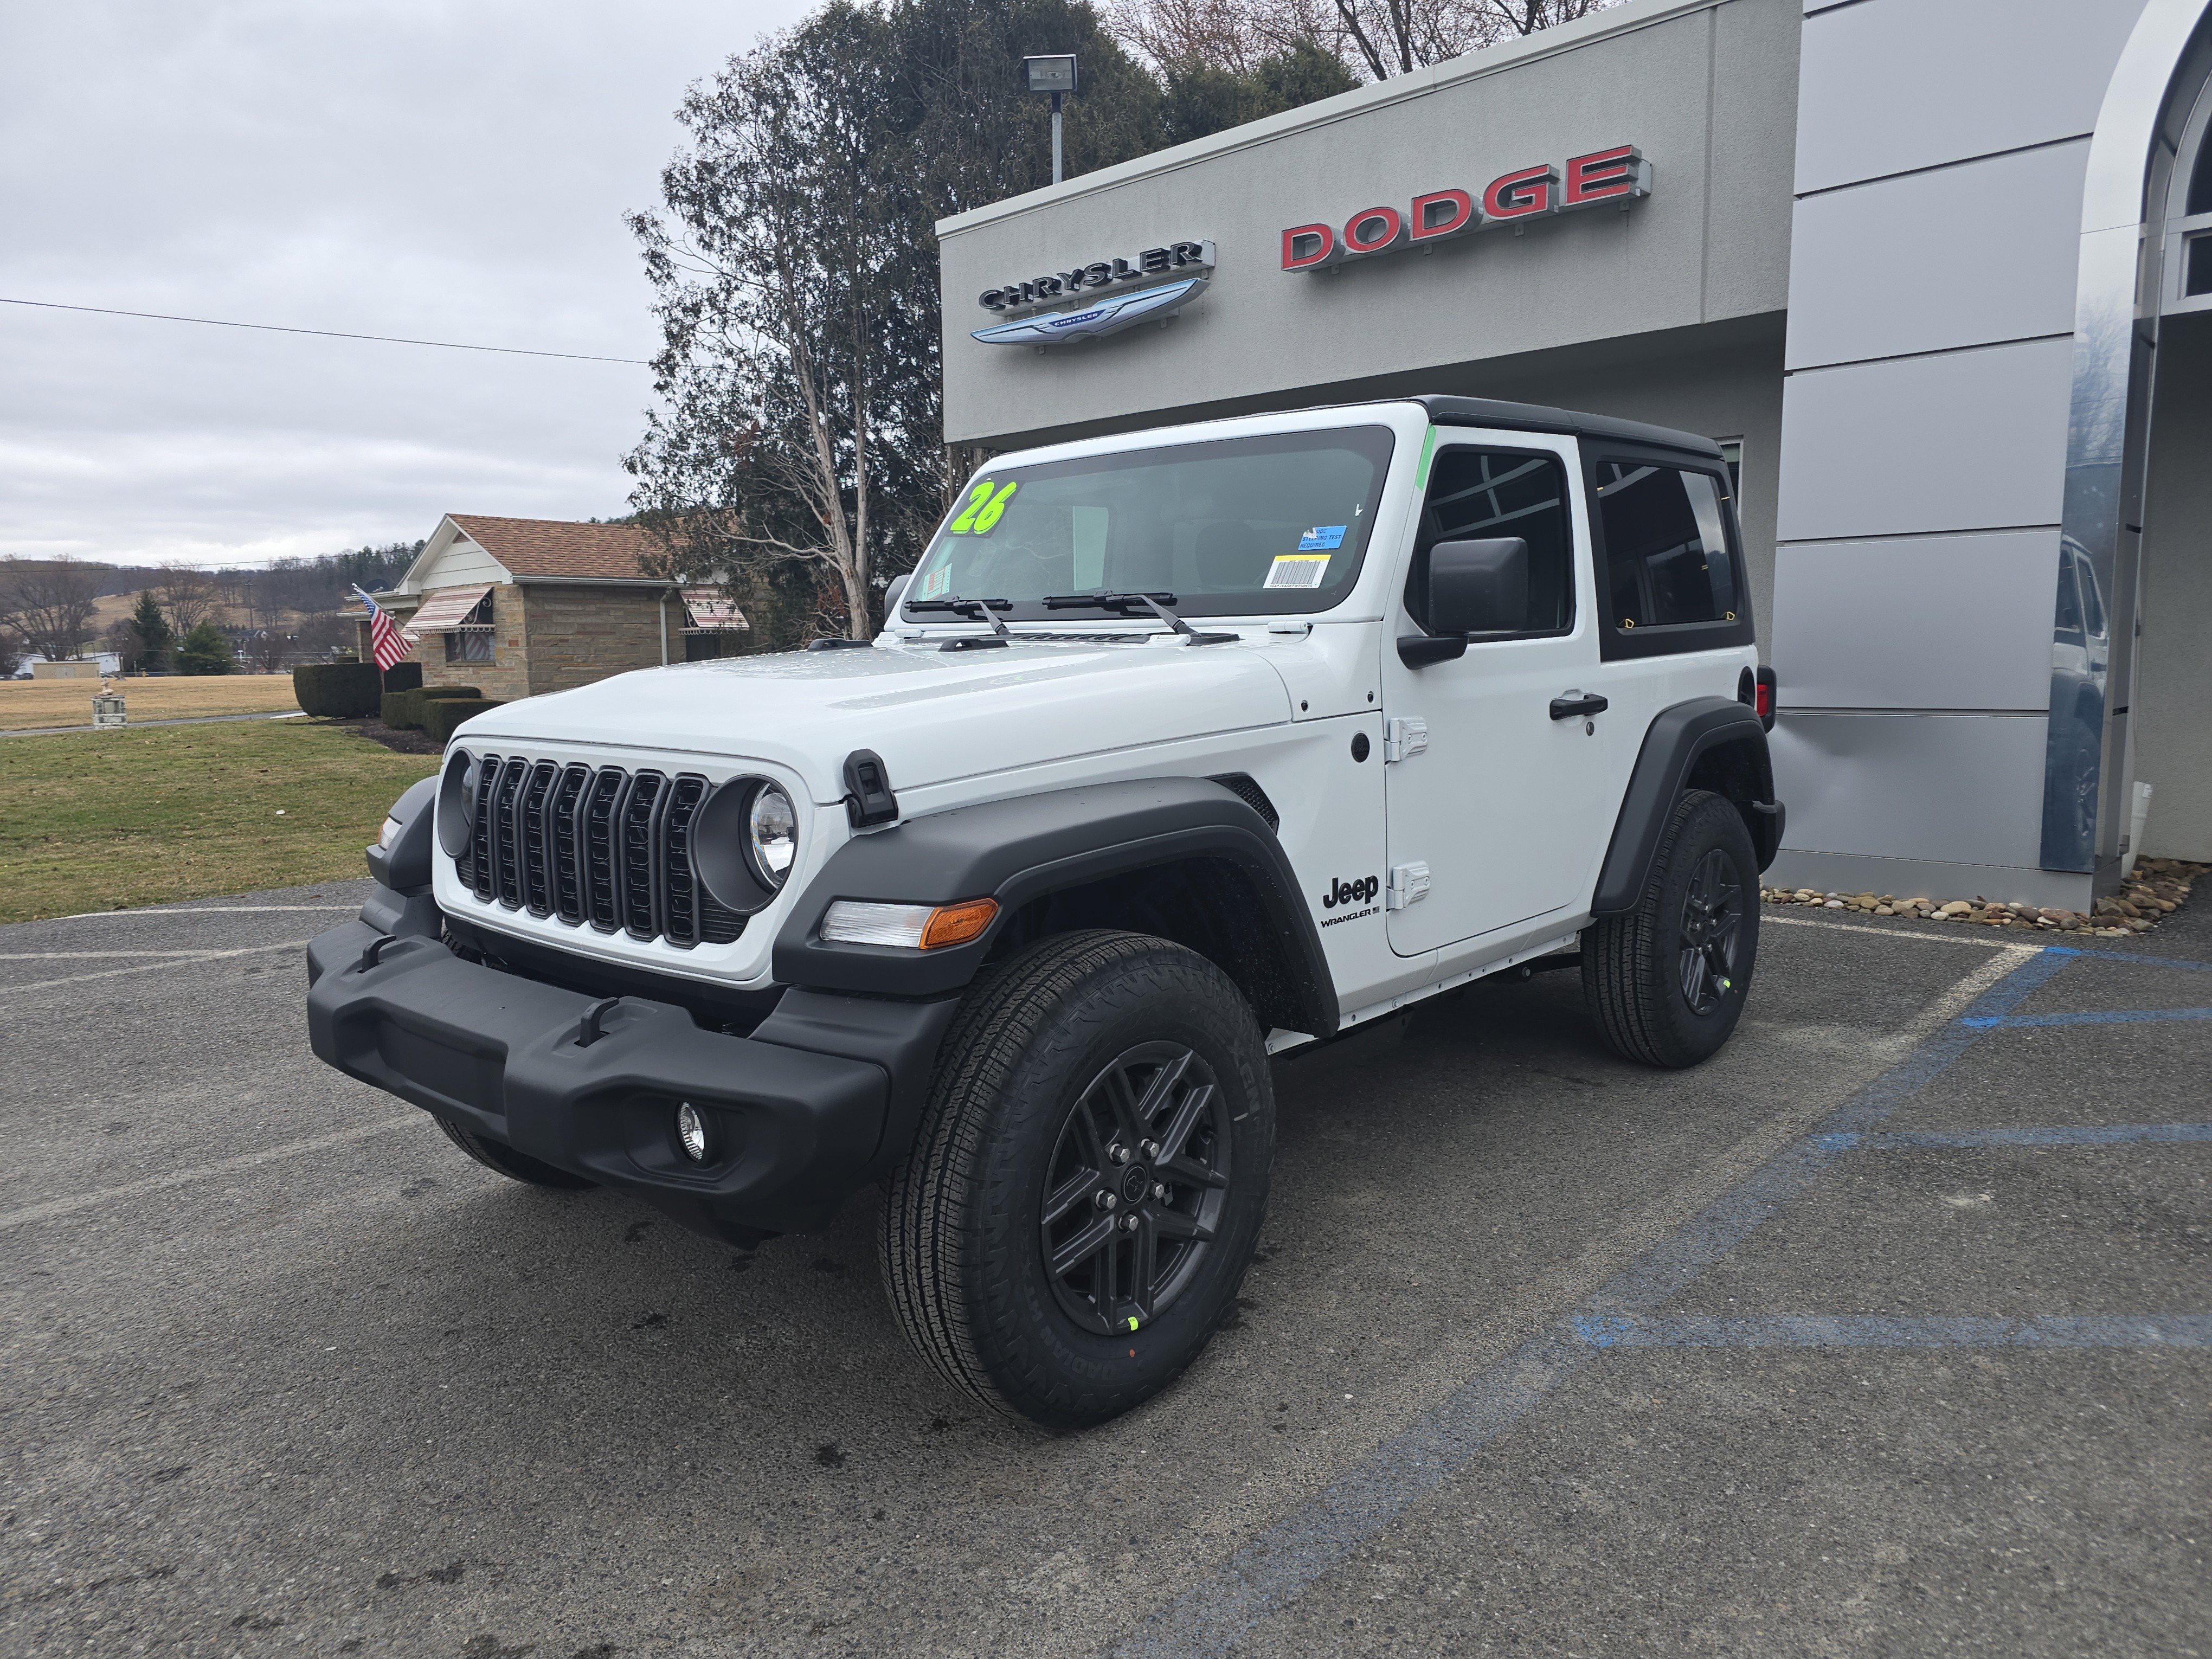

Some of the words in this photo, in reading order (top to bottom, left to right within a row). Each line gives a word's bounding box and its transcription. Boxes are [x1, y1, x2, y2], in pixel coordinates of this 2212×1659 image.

[1281, 145, 1638, 271] DODGE
[979, 241, 1203, 310] CHRYSLER
[1054, 312, 1098, 326] CHRYSLER
[950, 481, 1017, 534] 26
[1323, 875, 1379, 908] Jeep
[1321, 909, 1371, 928] WRANGLER
